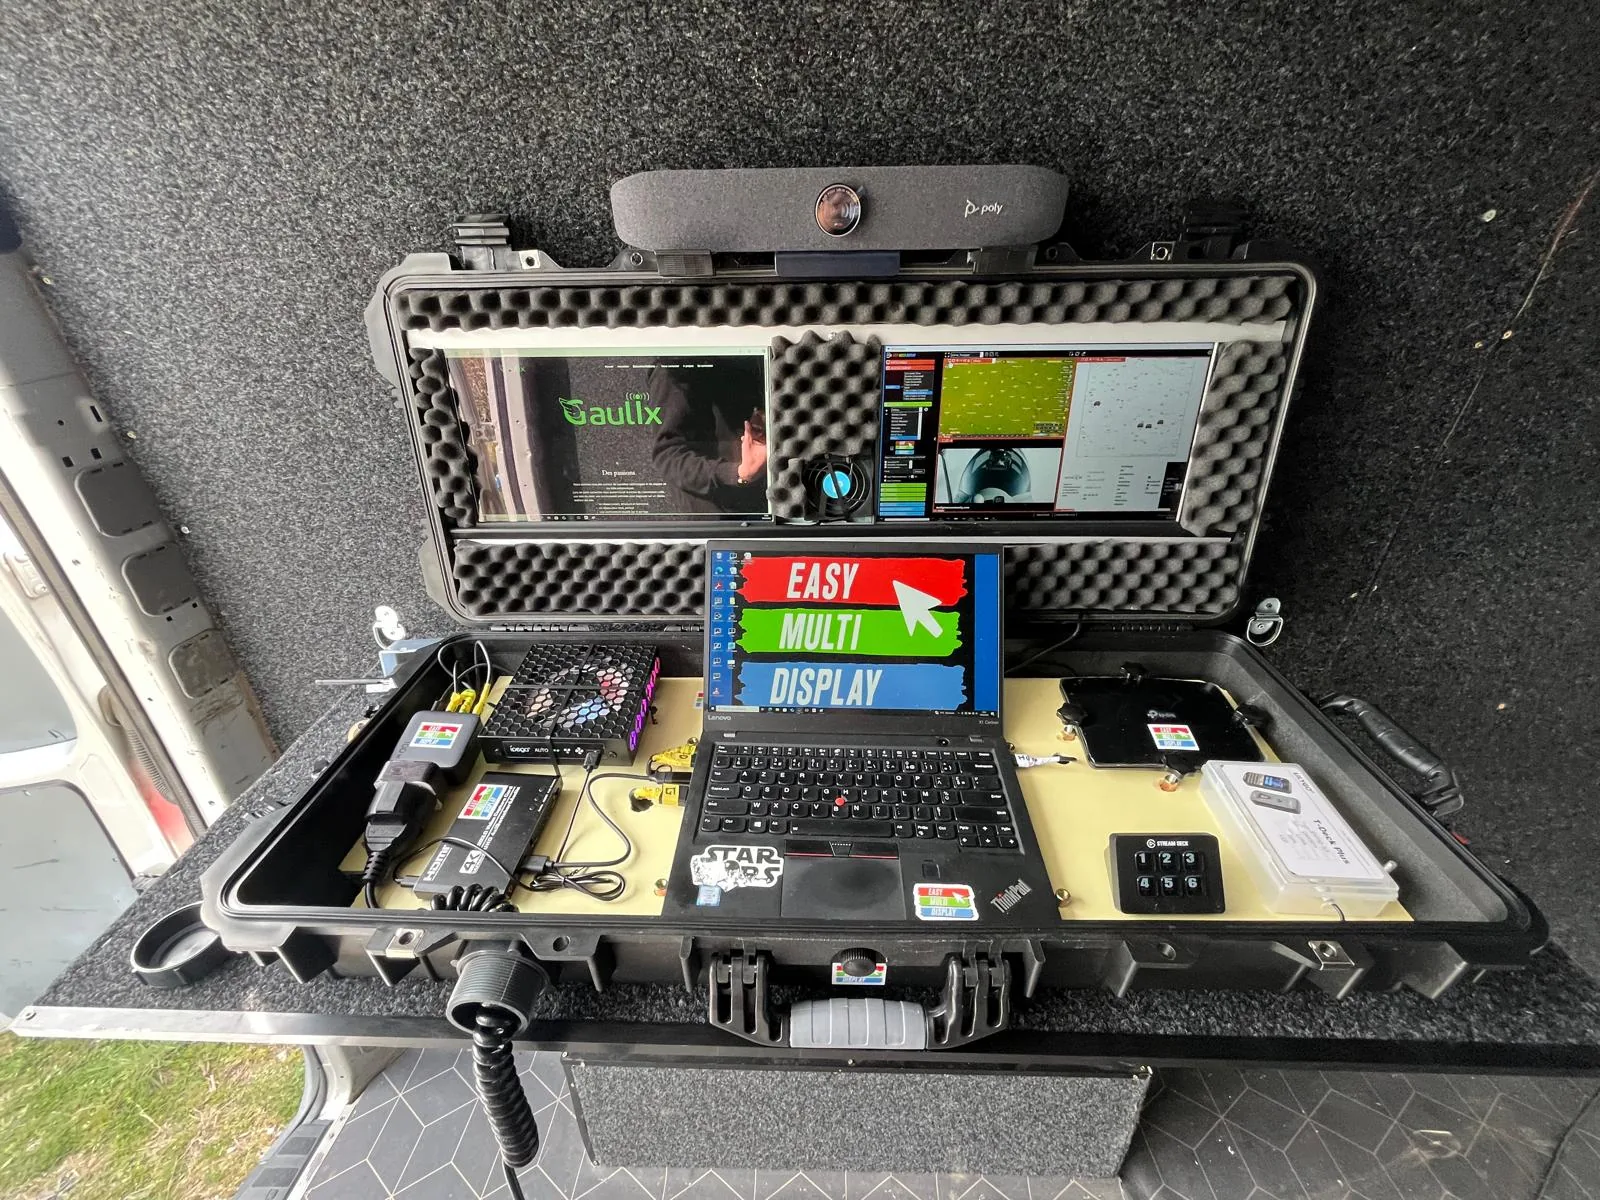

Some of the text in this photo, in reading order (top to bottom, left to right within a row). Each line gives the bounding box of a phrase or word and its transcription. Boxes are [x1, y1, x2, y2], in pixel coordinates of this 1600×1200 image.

[981, 202, 1003, 215] poly
[786, 562, 859, 600] EASY
[779, 613, 862, 650] MULTI
[769, 668, 883, 706] DISPLAY
[700, 847, 780, 864] STAR
[1139, 853, 1146, 863] 1
[1162, 853, 1171, 863] 2
[1185, 853, 1195, 863] 3
[423, 844, 451, 881] HDMI
[464, 853, 481, 871] 4K
[1140, 878, 1149, 888] 4
[1164, 878, 1173, 888] 5
[1188, 878, 1197, 888] 6
[927, 887, 944, 896] EASY
[990, 878, 1032, 913] ThinkPad
[931, 908, 957, 917] DISPLAY
